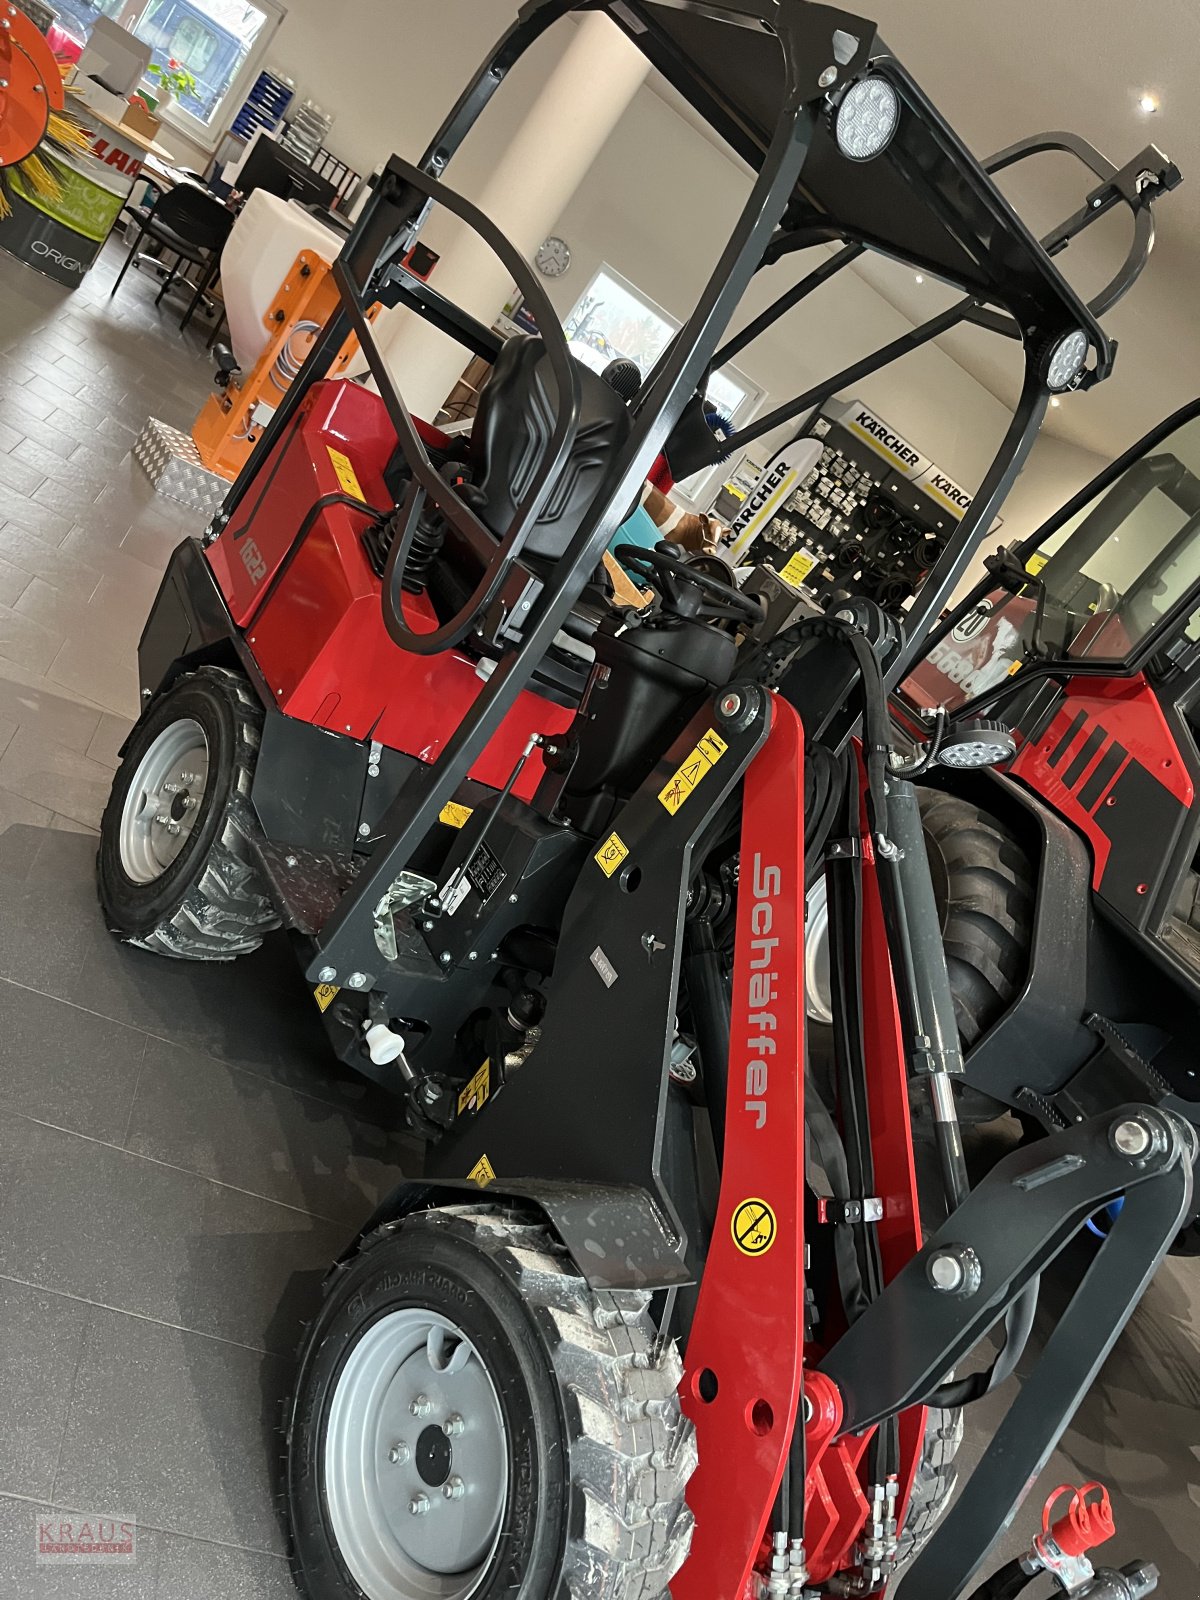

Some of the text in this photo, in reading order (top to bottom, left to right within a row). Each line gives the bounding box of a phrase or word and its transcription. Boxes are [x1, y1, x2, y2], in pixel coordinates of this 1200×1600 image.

[856, 411, 920, 467] KÄRCHER
[721, 461, 791, 549] KÄRCHER
[239, 537, 267, 586] 1622
[745, 852, 781, 1130] Schäffer
